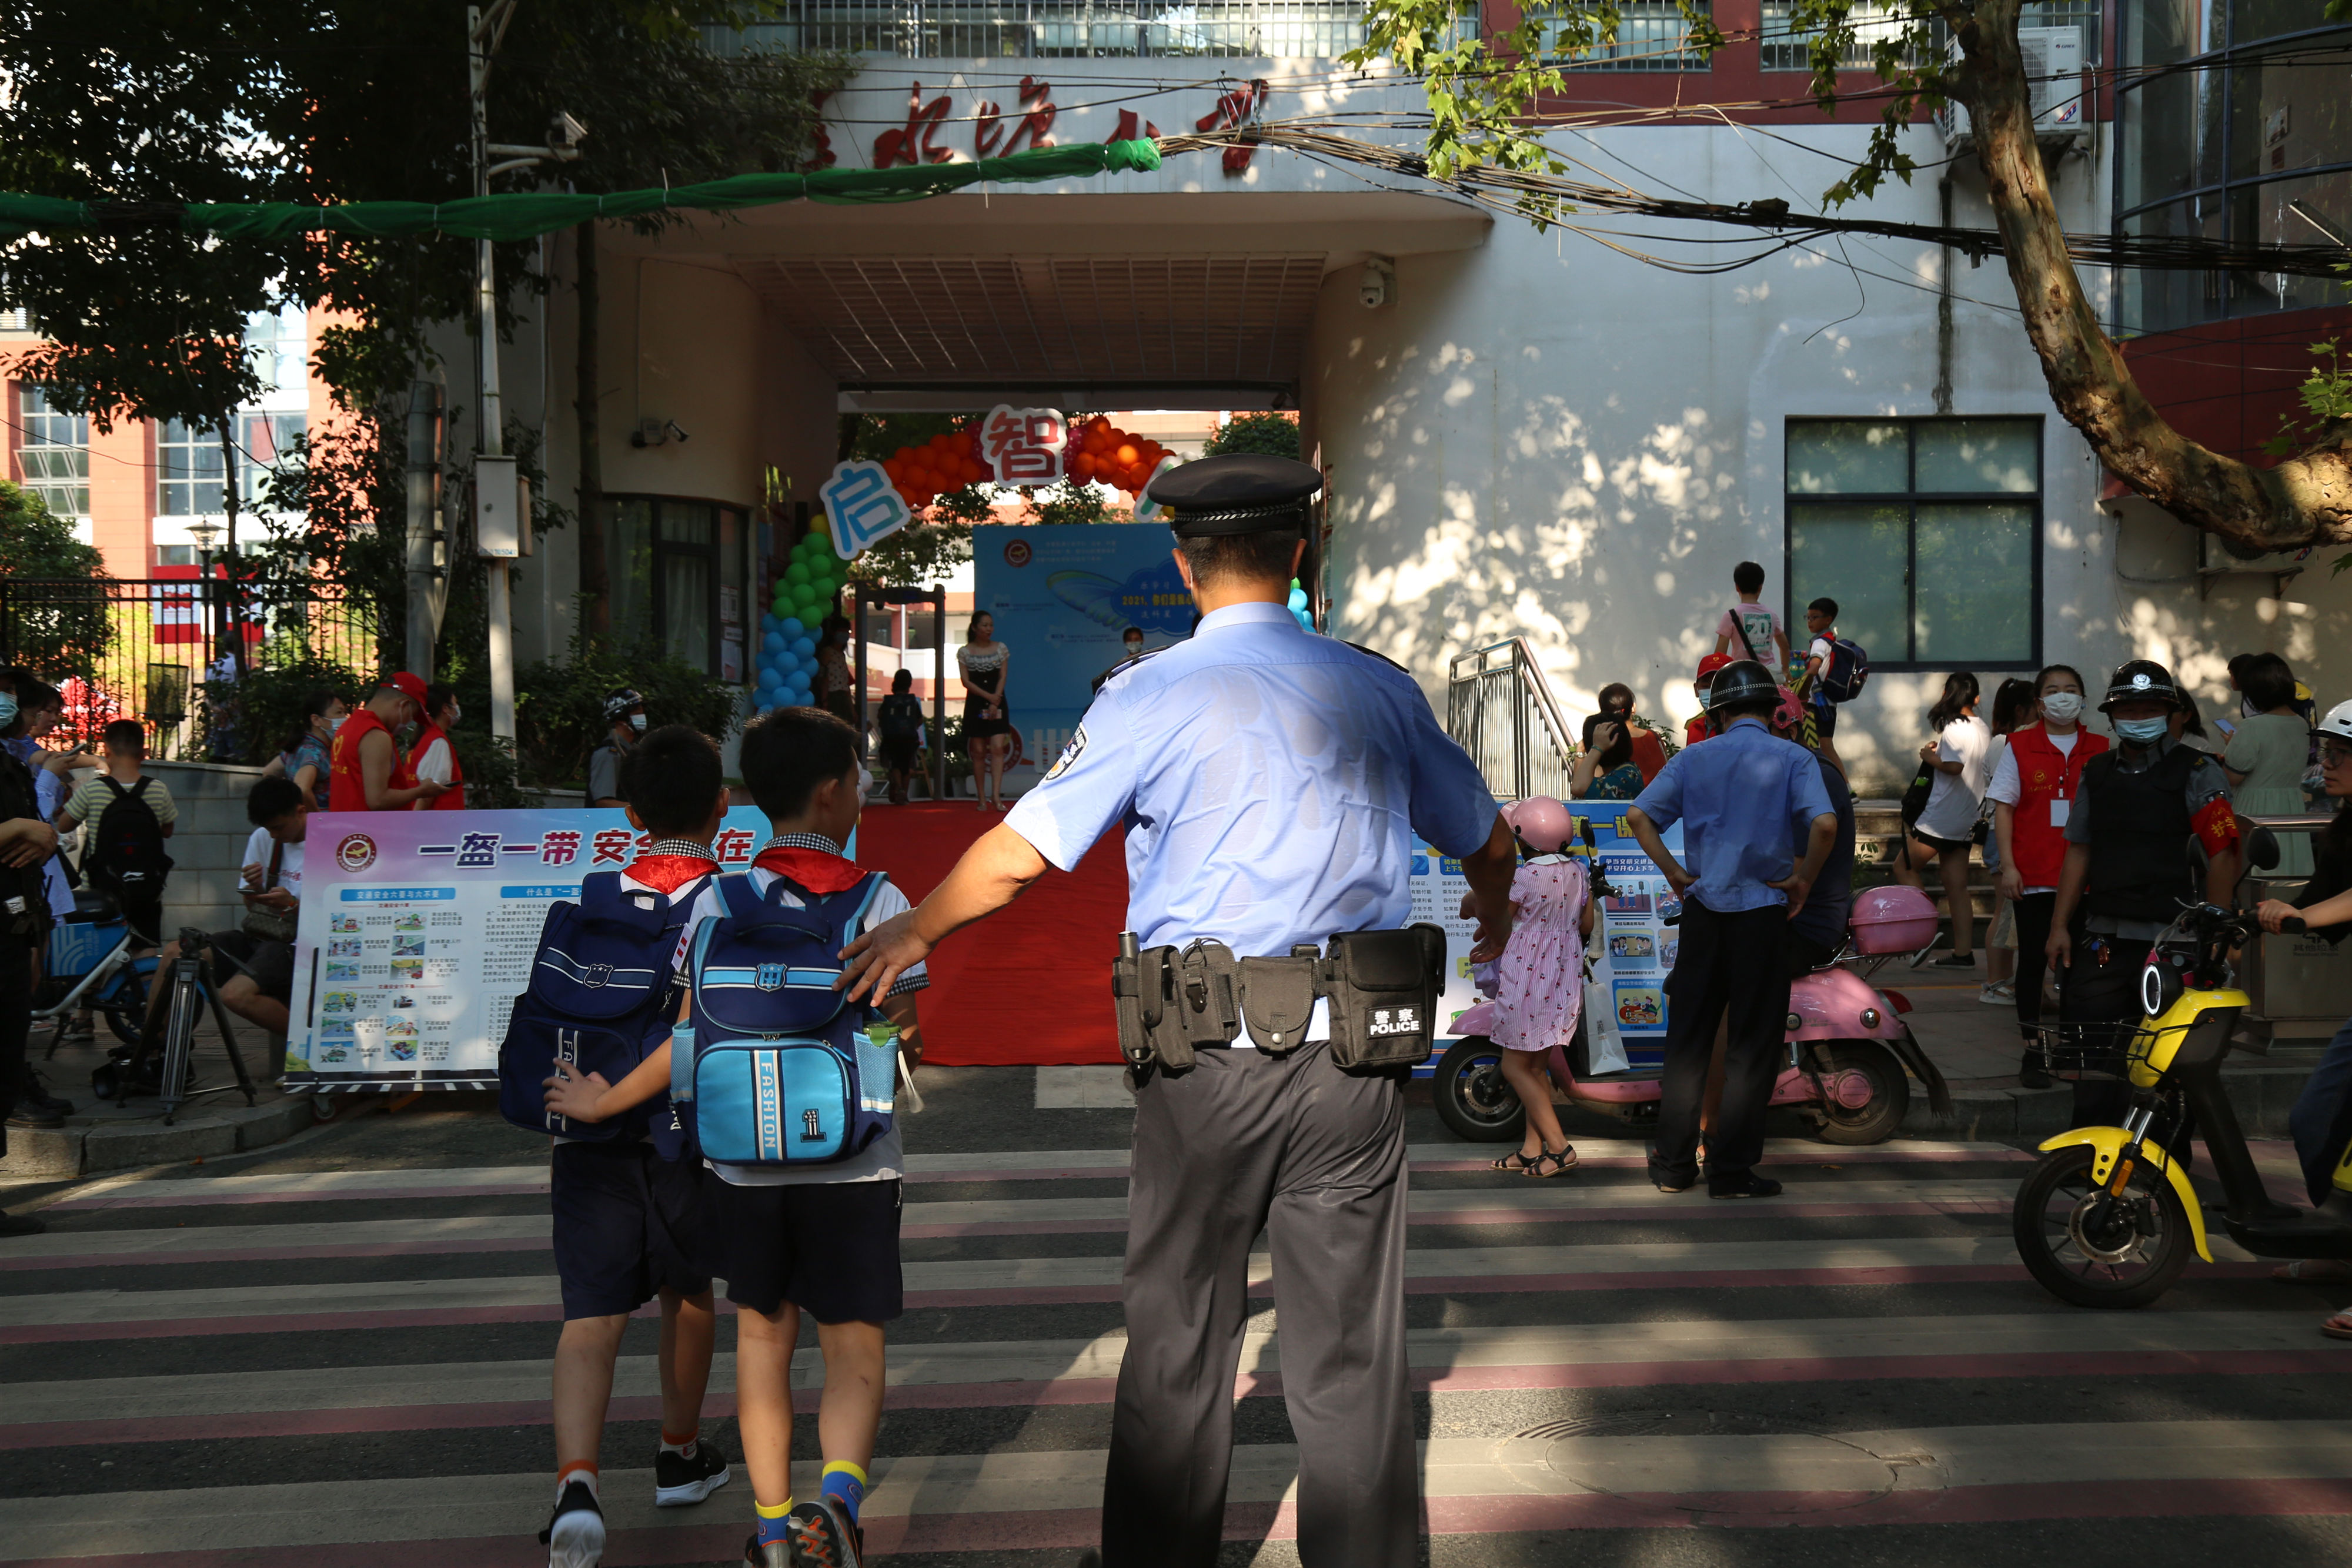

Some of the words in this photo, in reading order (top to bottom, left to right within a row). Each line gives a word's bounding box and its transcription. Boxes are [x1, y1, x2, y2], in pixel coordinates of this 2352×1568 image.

[988, 412, 1059, 479] 智
[828, 467, 903, 548] 启
[417, 829, 582, 868] 一盔一带
[592, 827, 756, 865] 安在
[357, 890, 439, 900] 交通安全六要与六不要
[526, 887, 582, 897] 什么是“一盔
[1369, 1019, 1420, 1036] POLICE
[1374, 1008, 1414, 1025] 警察
[761, 1062, 776, 1148] FASHION
